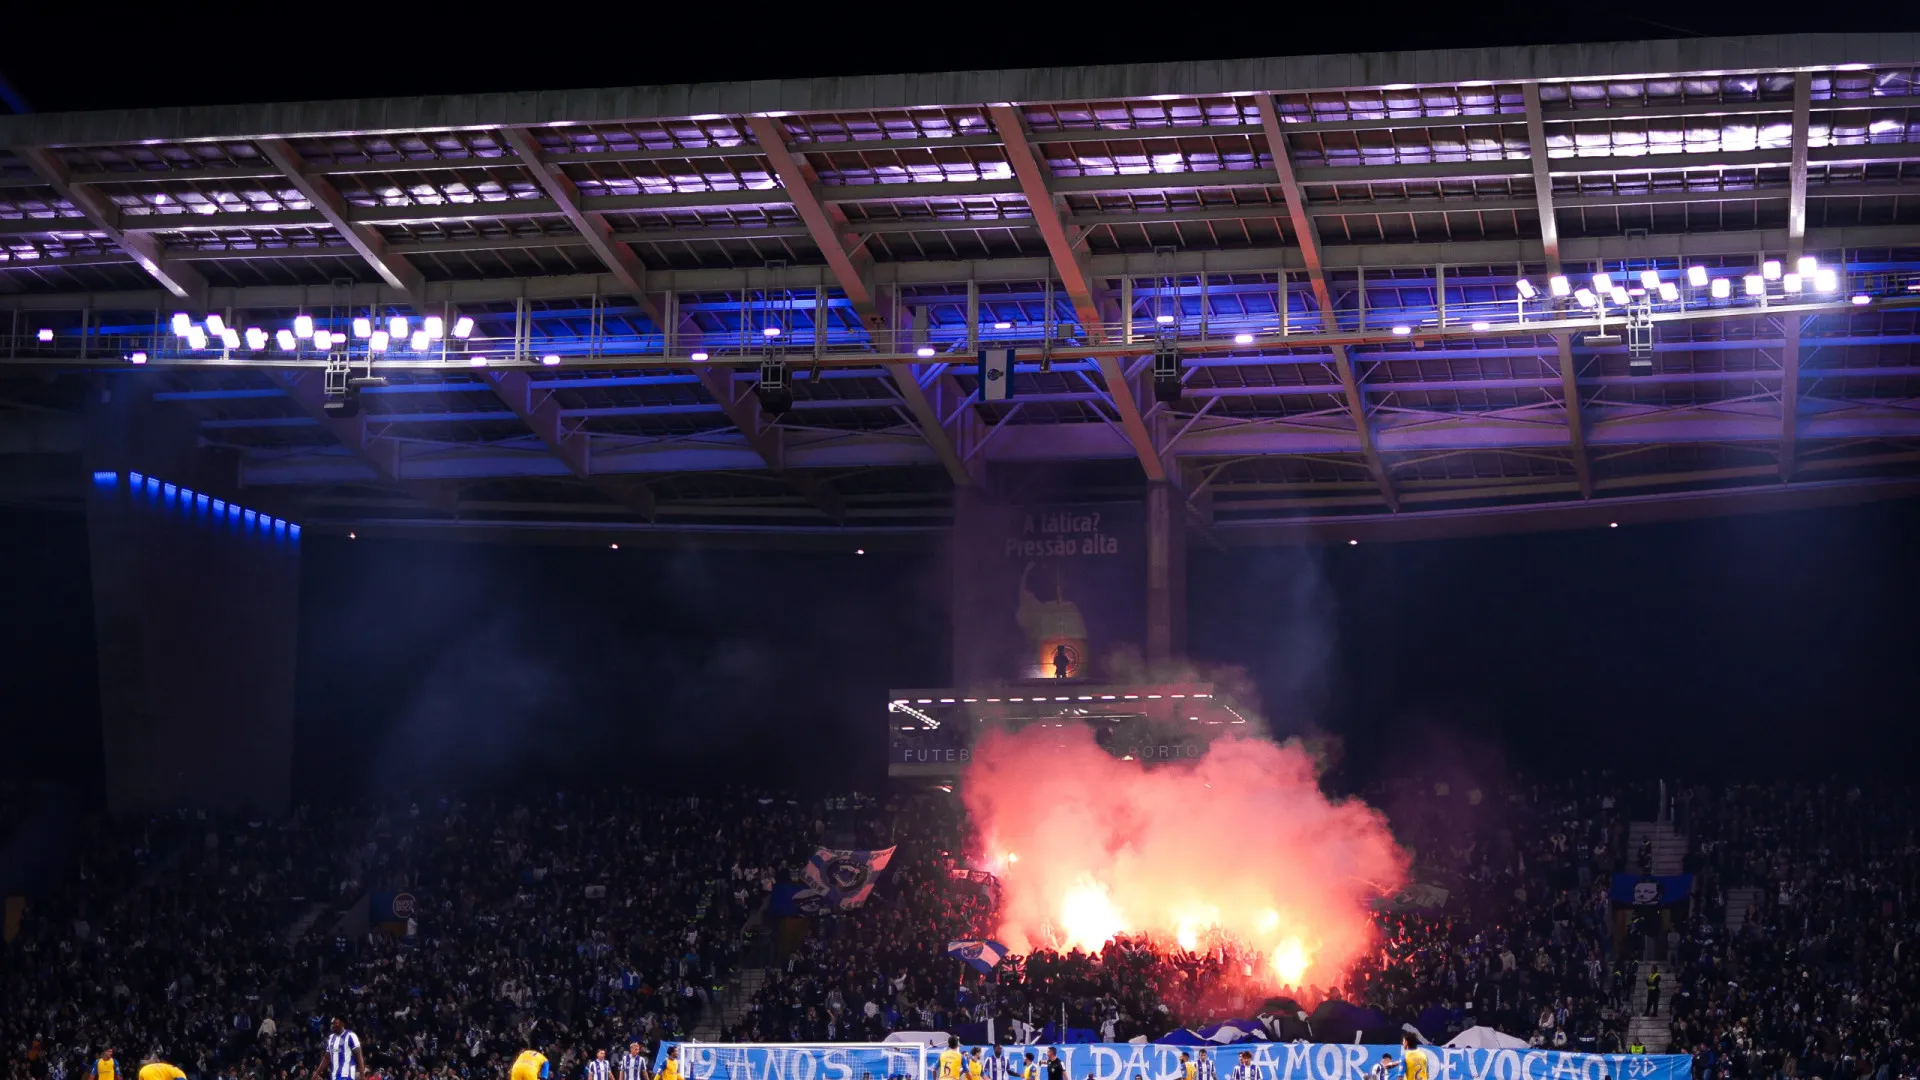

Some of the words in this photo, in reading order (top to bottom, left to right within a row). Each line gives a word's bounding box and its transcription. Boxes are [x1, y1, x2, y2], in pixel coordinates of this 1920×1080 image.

[1023, 513, 1034, 533] A
[1005, 535, 1076, 557] Pressão
[1082, 533, 1118, 555] alta
[904, 748, 970, 762] FUTEB
[726, 1047, 853, 1080] ANOS
[1252, 1043, 1369, 1080] AMOR
[944, 1061, 952, 1076] 6
